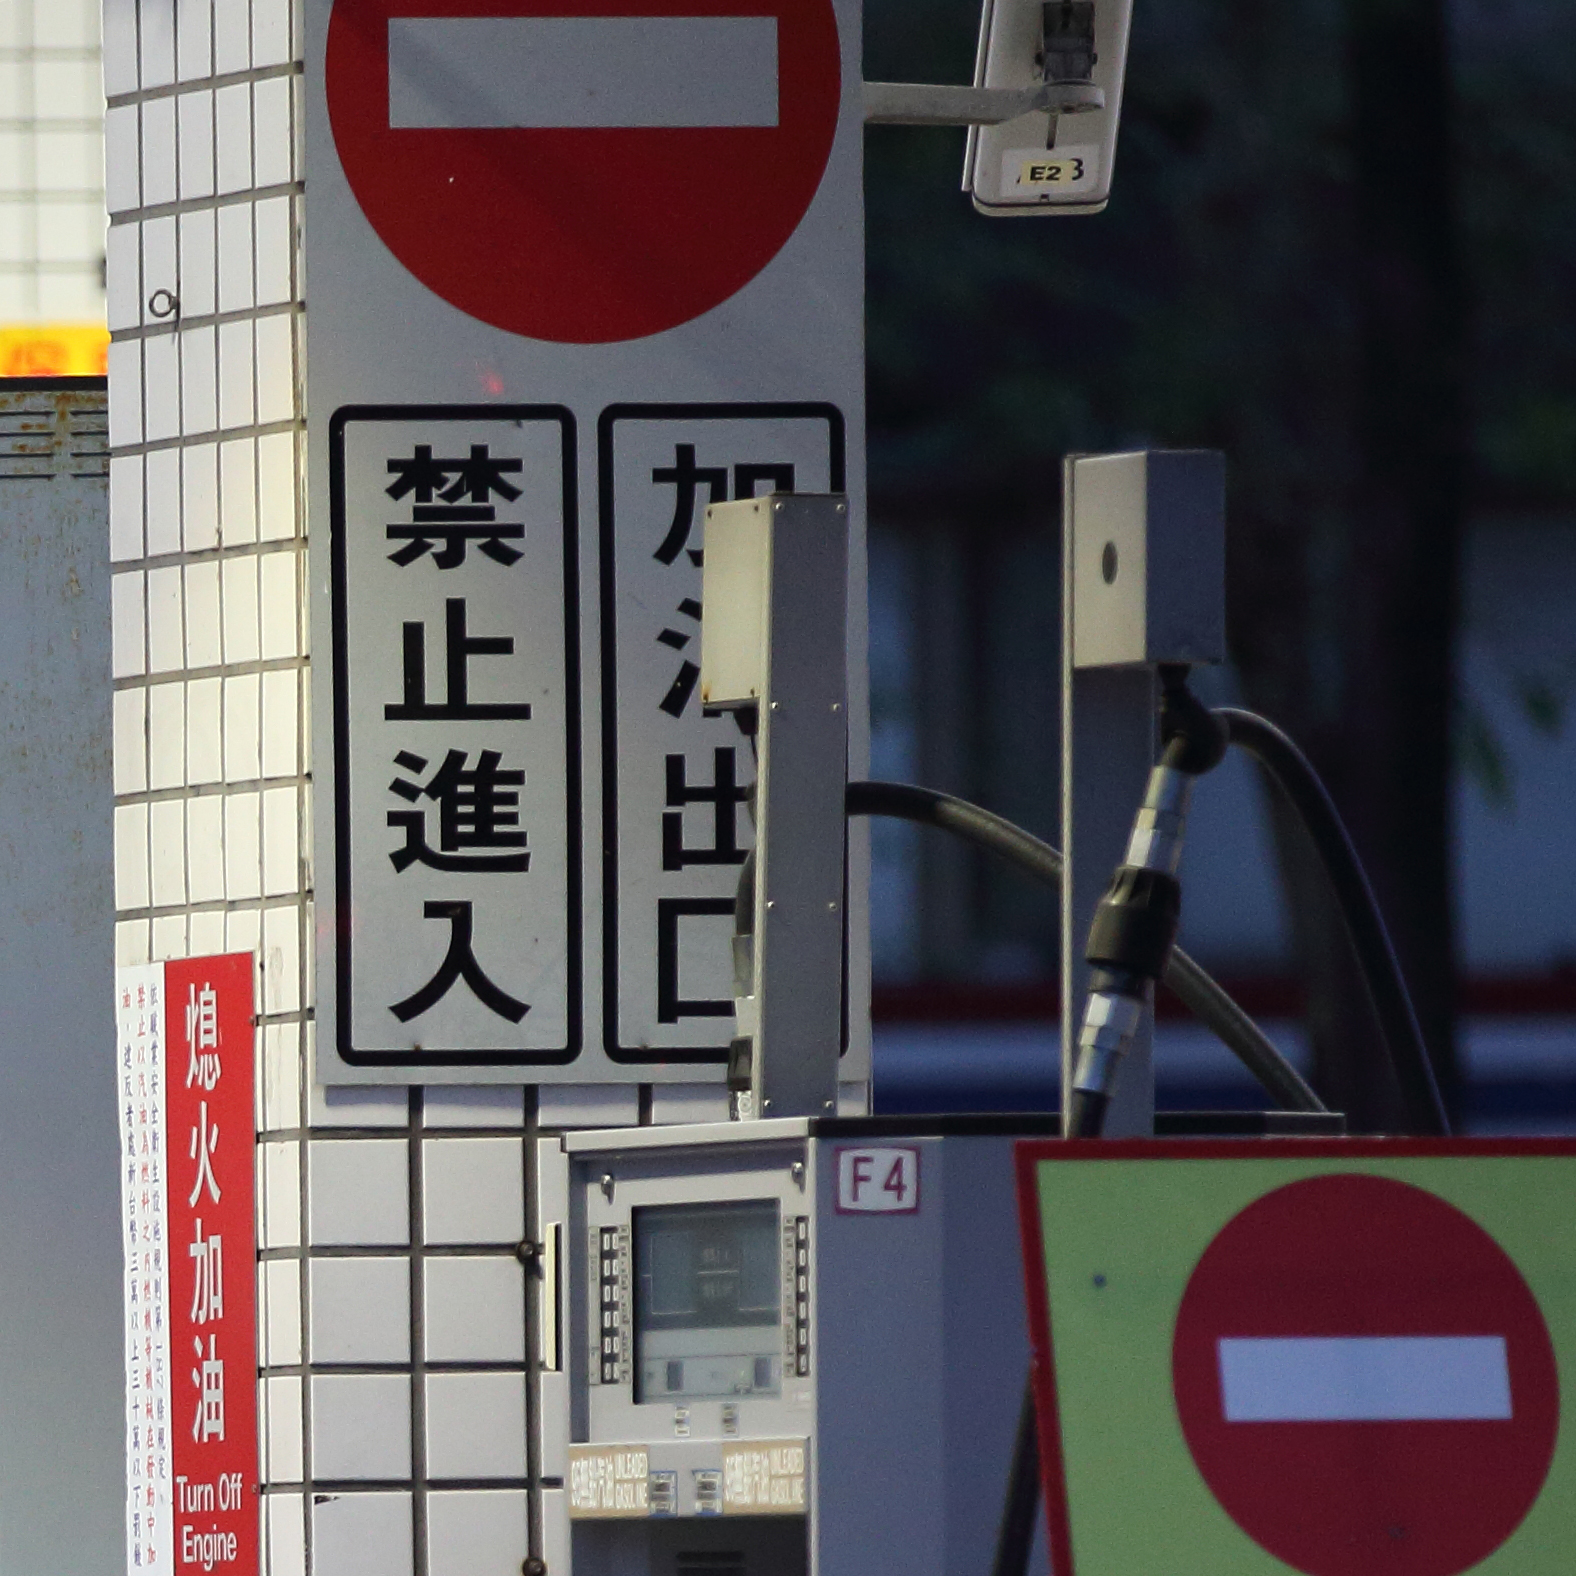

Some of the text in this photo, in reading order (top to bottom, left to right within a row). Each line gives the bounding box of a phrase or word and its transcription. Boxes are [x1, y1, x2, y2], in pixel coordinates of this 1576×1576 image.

[1029, 165, 1062, 181] E2
[384, 443, 532, 1025] 禁止進入
[851, 1153, 907, 1202] F4
[184, 981, 225, 1444] 熄火加油
[175, 1472, 243, 1513] Turn Off
[181, 1524, 238, 1570] Engine
